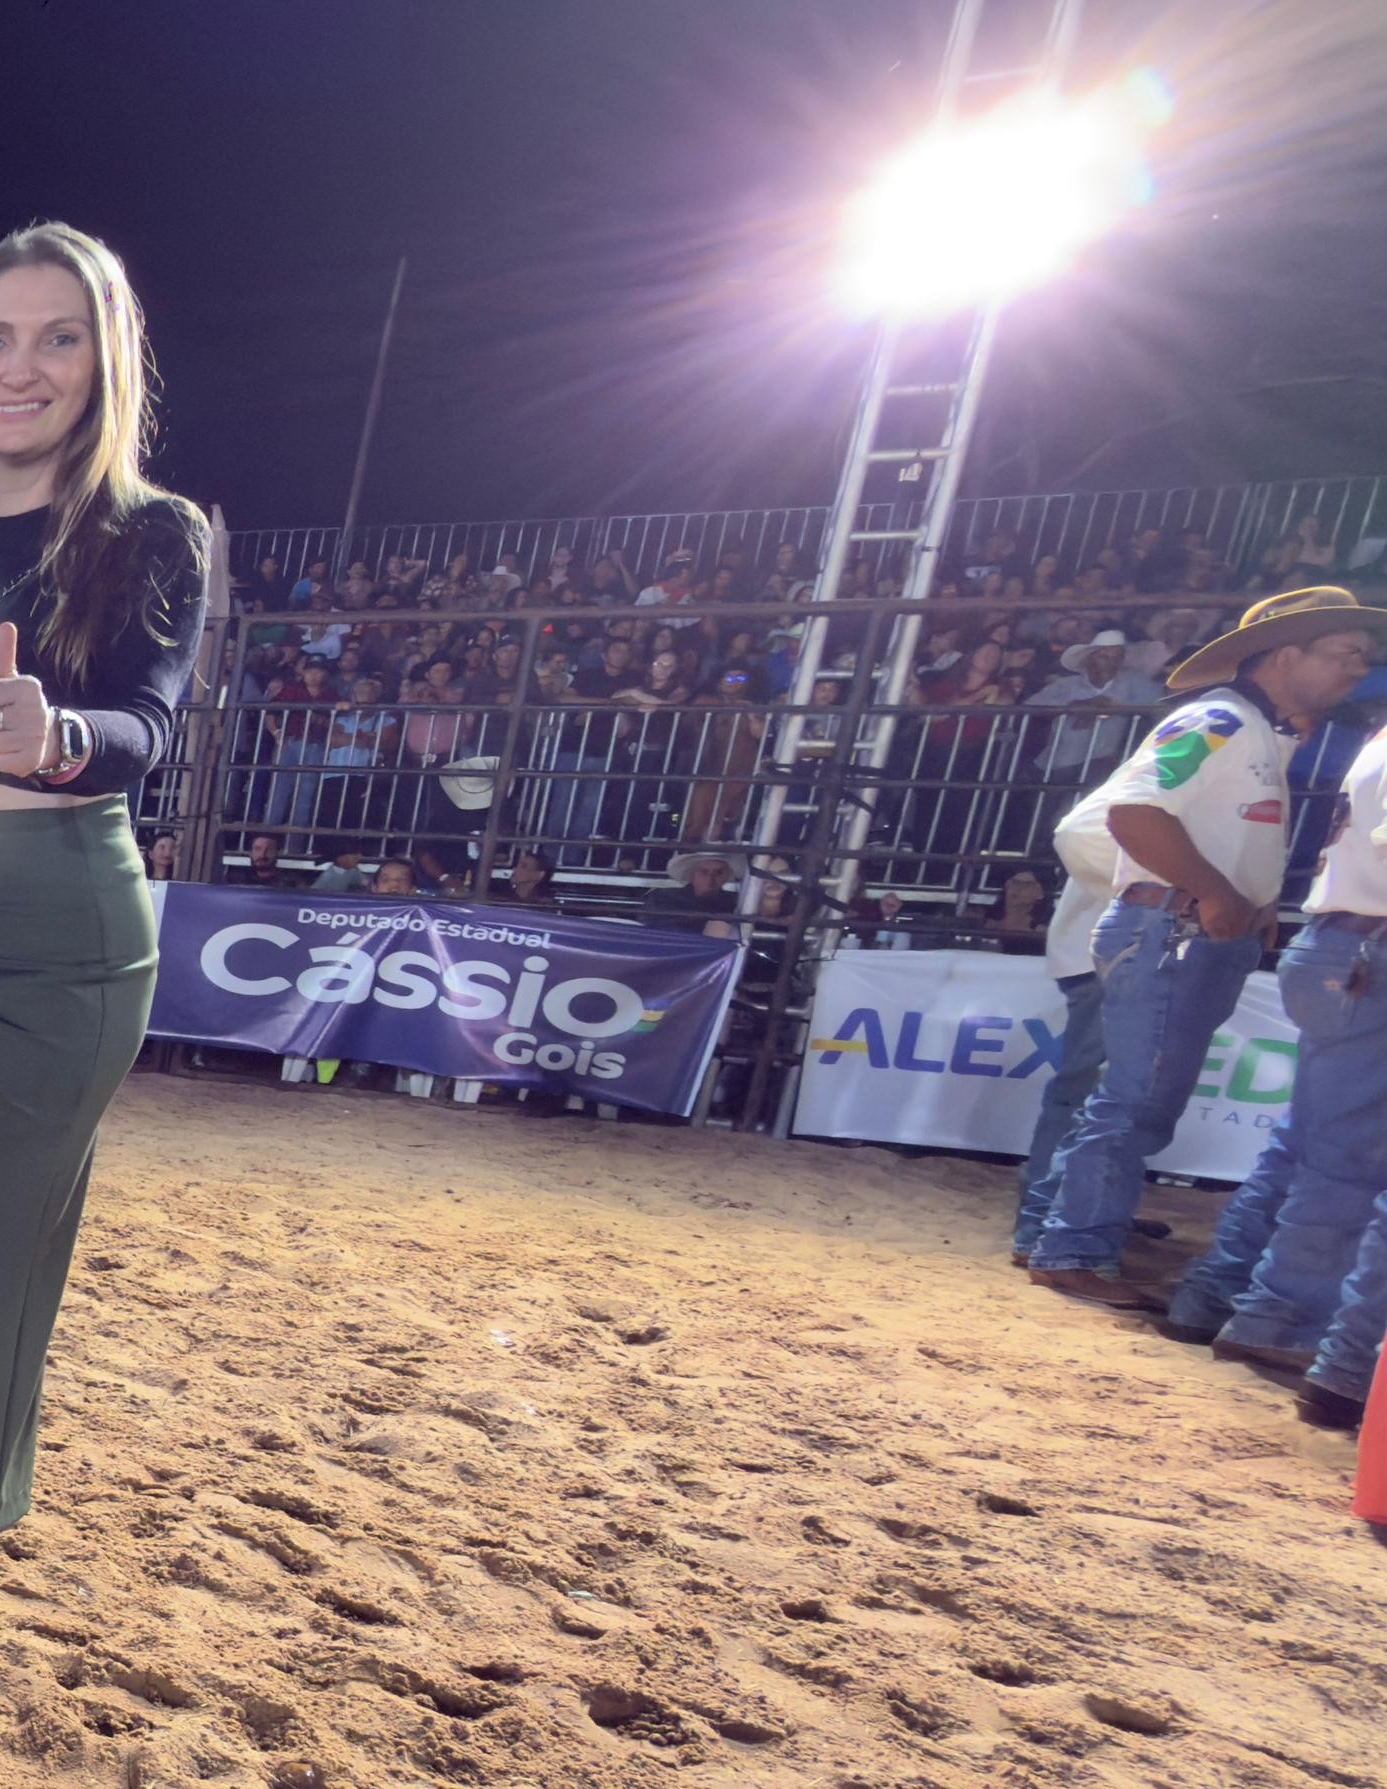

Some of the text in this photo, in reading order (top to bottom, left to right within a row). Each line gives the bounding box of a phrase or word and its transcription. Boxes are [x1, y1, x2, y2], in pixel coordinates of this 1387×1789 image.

[297, 908, 552, 949] Deputado Estadual
[200, 923, 645, 1039] Cássio
[493, 1031, 627, 1080] Gois
[1193, 1033, 1299, 1105] ED
[1199, 1106, 1275, 1129] TAD
